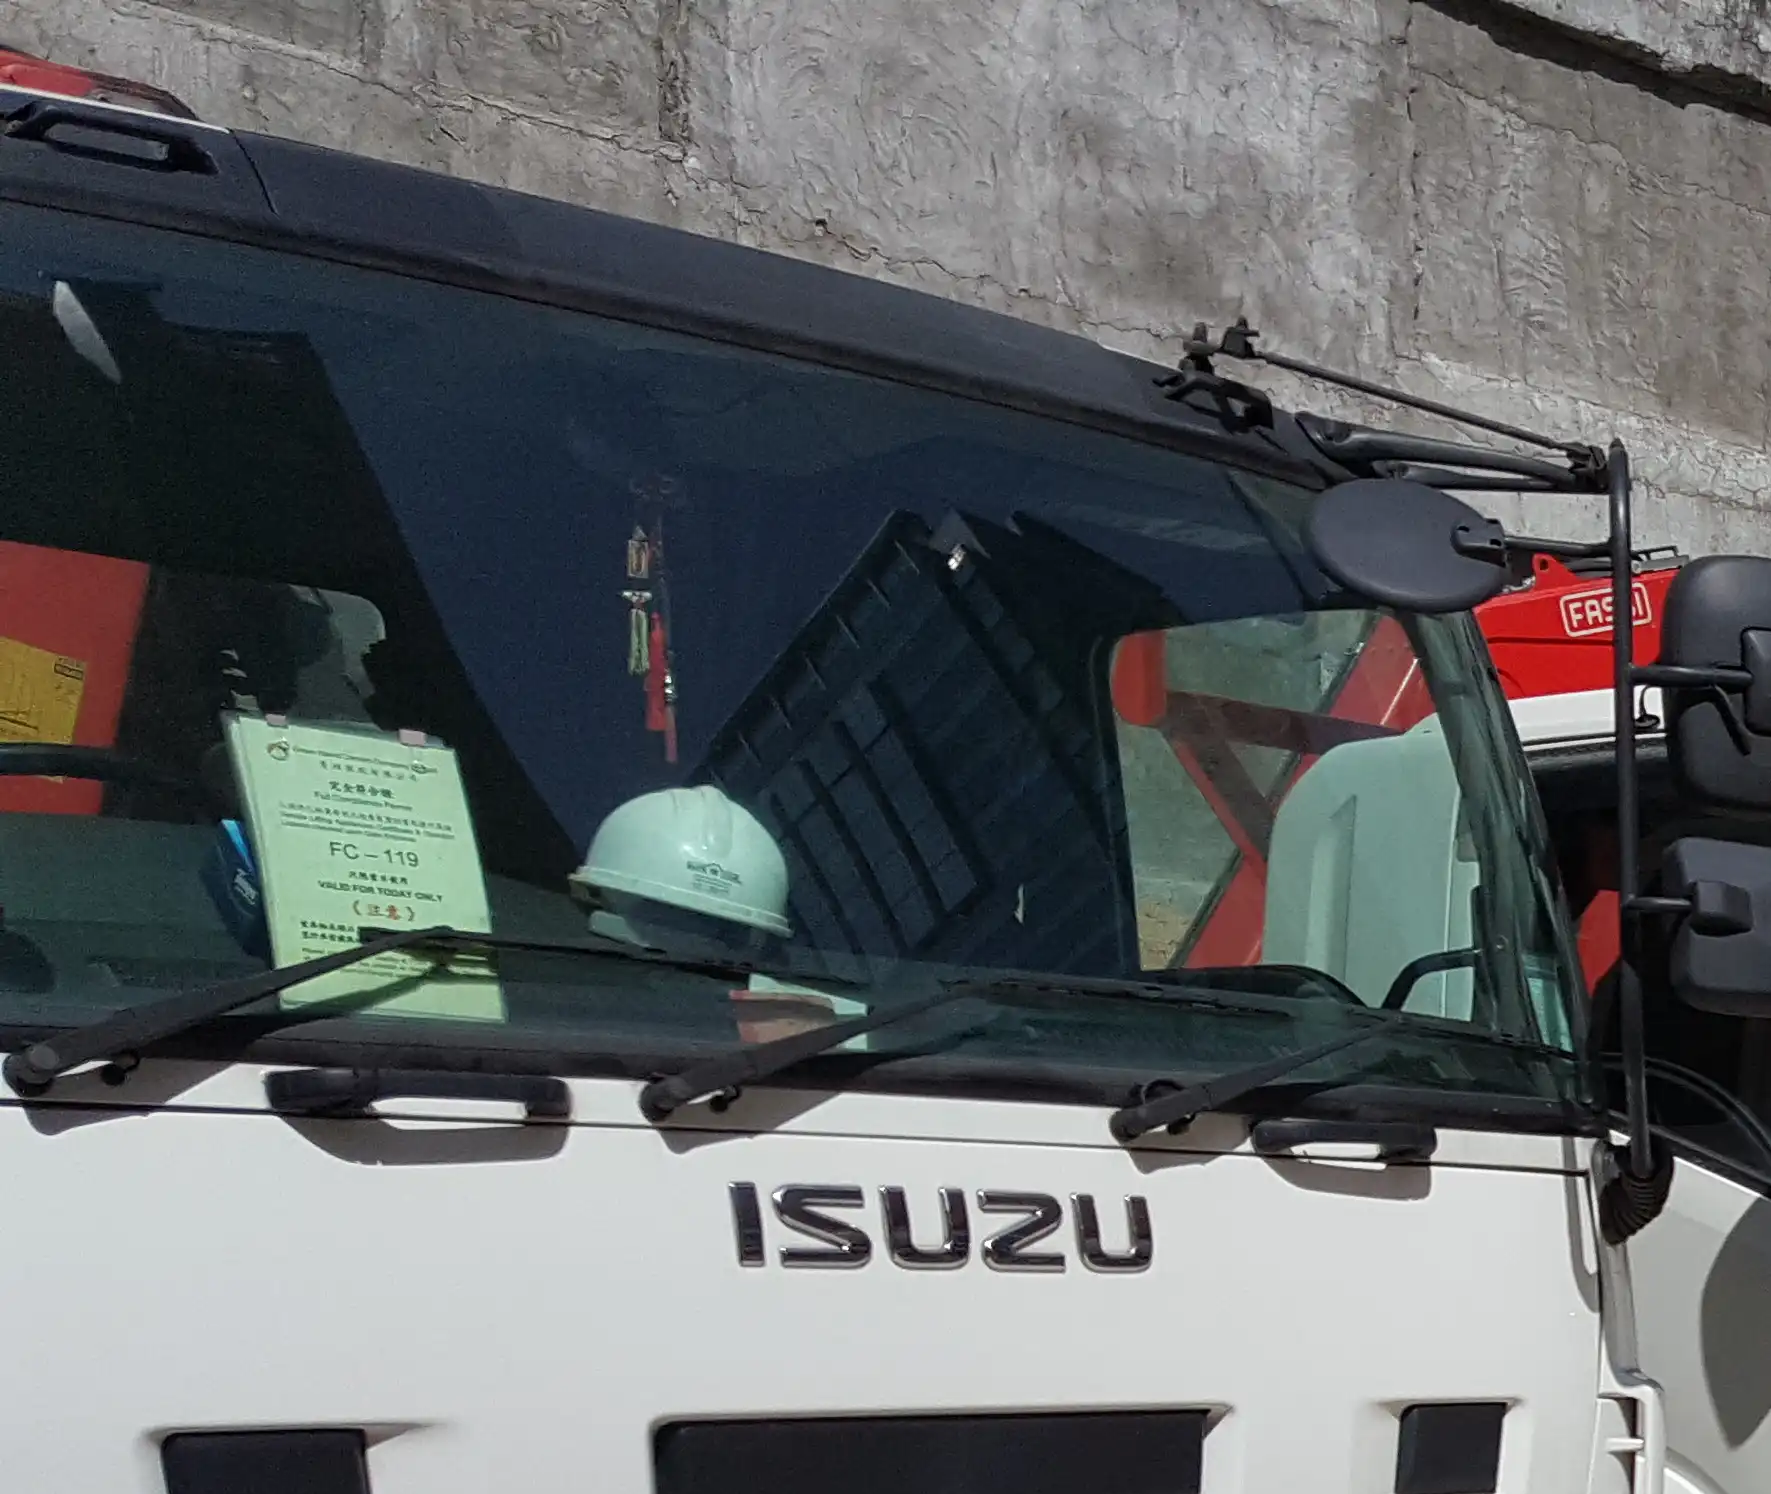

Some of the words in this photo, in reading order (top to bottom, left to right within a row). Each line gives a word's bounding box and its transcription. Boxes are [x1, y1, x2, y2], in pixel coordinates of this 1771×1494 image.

[1568, 591, 1644, 628] FASI
[329, 841, 360, 860] FC
[384, 849, 419, 868] 119
[317, 880, 351, 893] VALID
[352, 883, 375, 895] FOR
[376, 886, 412, 900] TODAY
[414, 891, 444, 903] ONLY
[728, 1181, 1154, 1274] ISUZU
